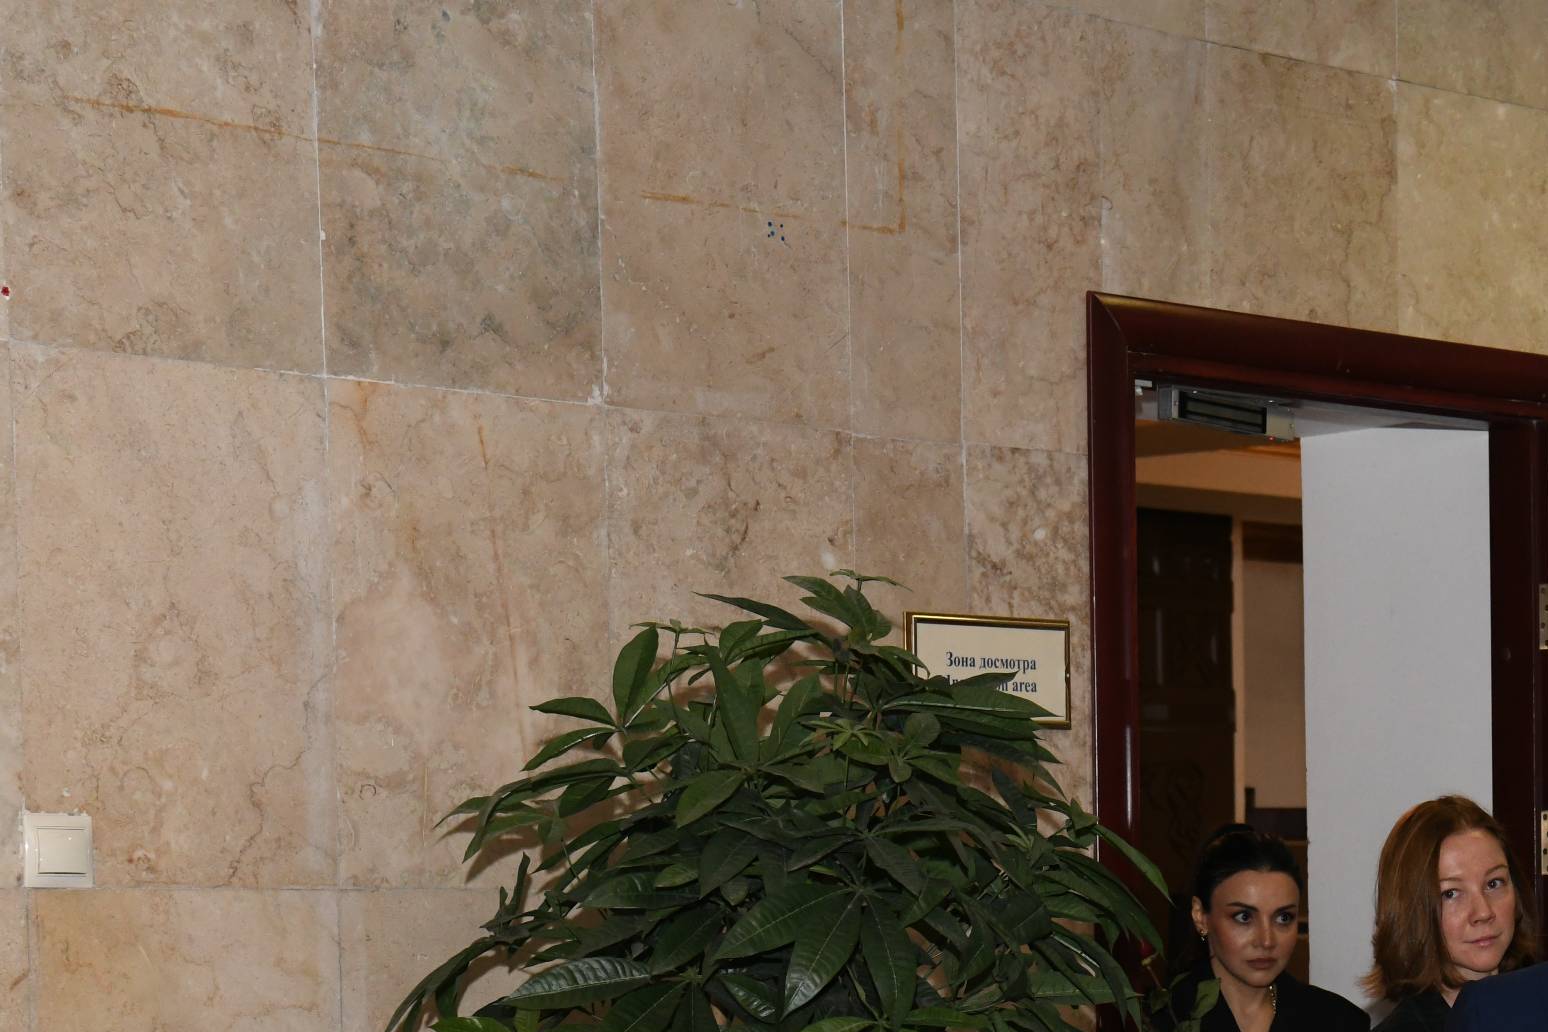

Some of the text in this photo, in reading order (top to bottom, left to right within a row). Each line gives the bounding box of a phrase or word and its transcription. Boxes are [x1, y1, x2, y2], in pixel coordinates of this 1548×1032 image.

[946, 651, 1037, 674] Зона досмотра
[1012, 681, 1037, 693] area
